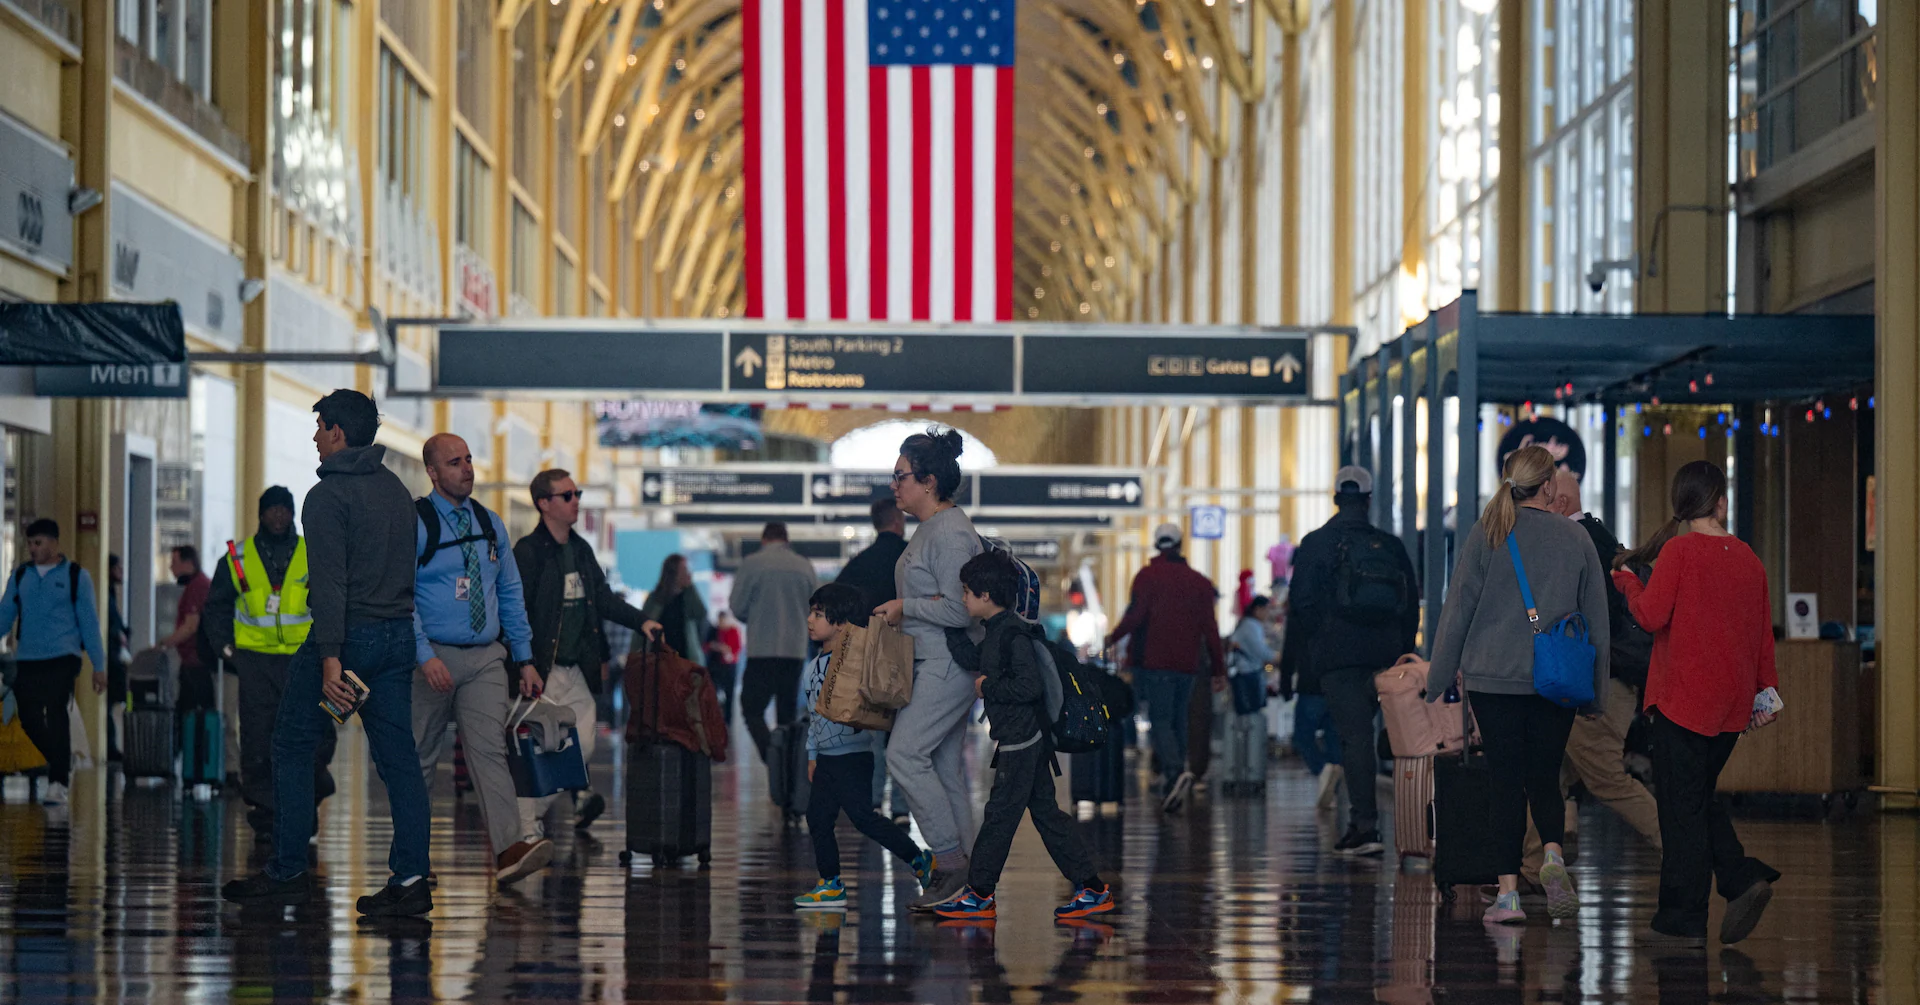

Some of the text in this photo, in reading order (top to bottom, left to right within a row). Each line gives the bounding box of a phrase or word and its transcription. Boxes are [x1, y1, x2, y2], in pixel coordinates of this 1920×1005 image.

[789, 336, 904, 356] South Parking 2
[788, 354, 835, 370] Metro
[1206, 358, 1249, 374] Gates
[91, 363, 149, 384] Men
[788, 371, 864, 388] Restrooms
